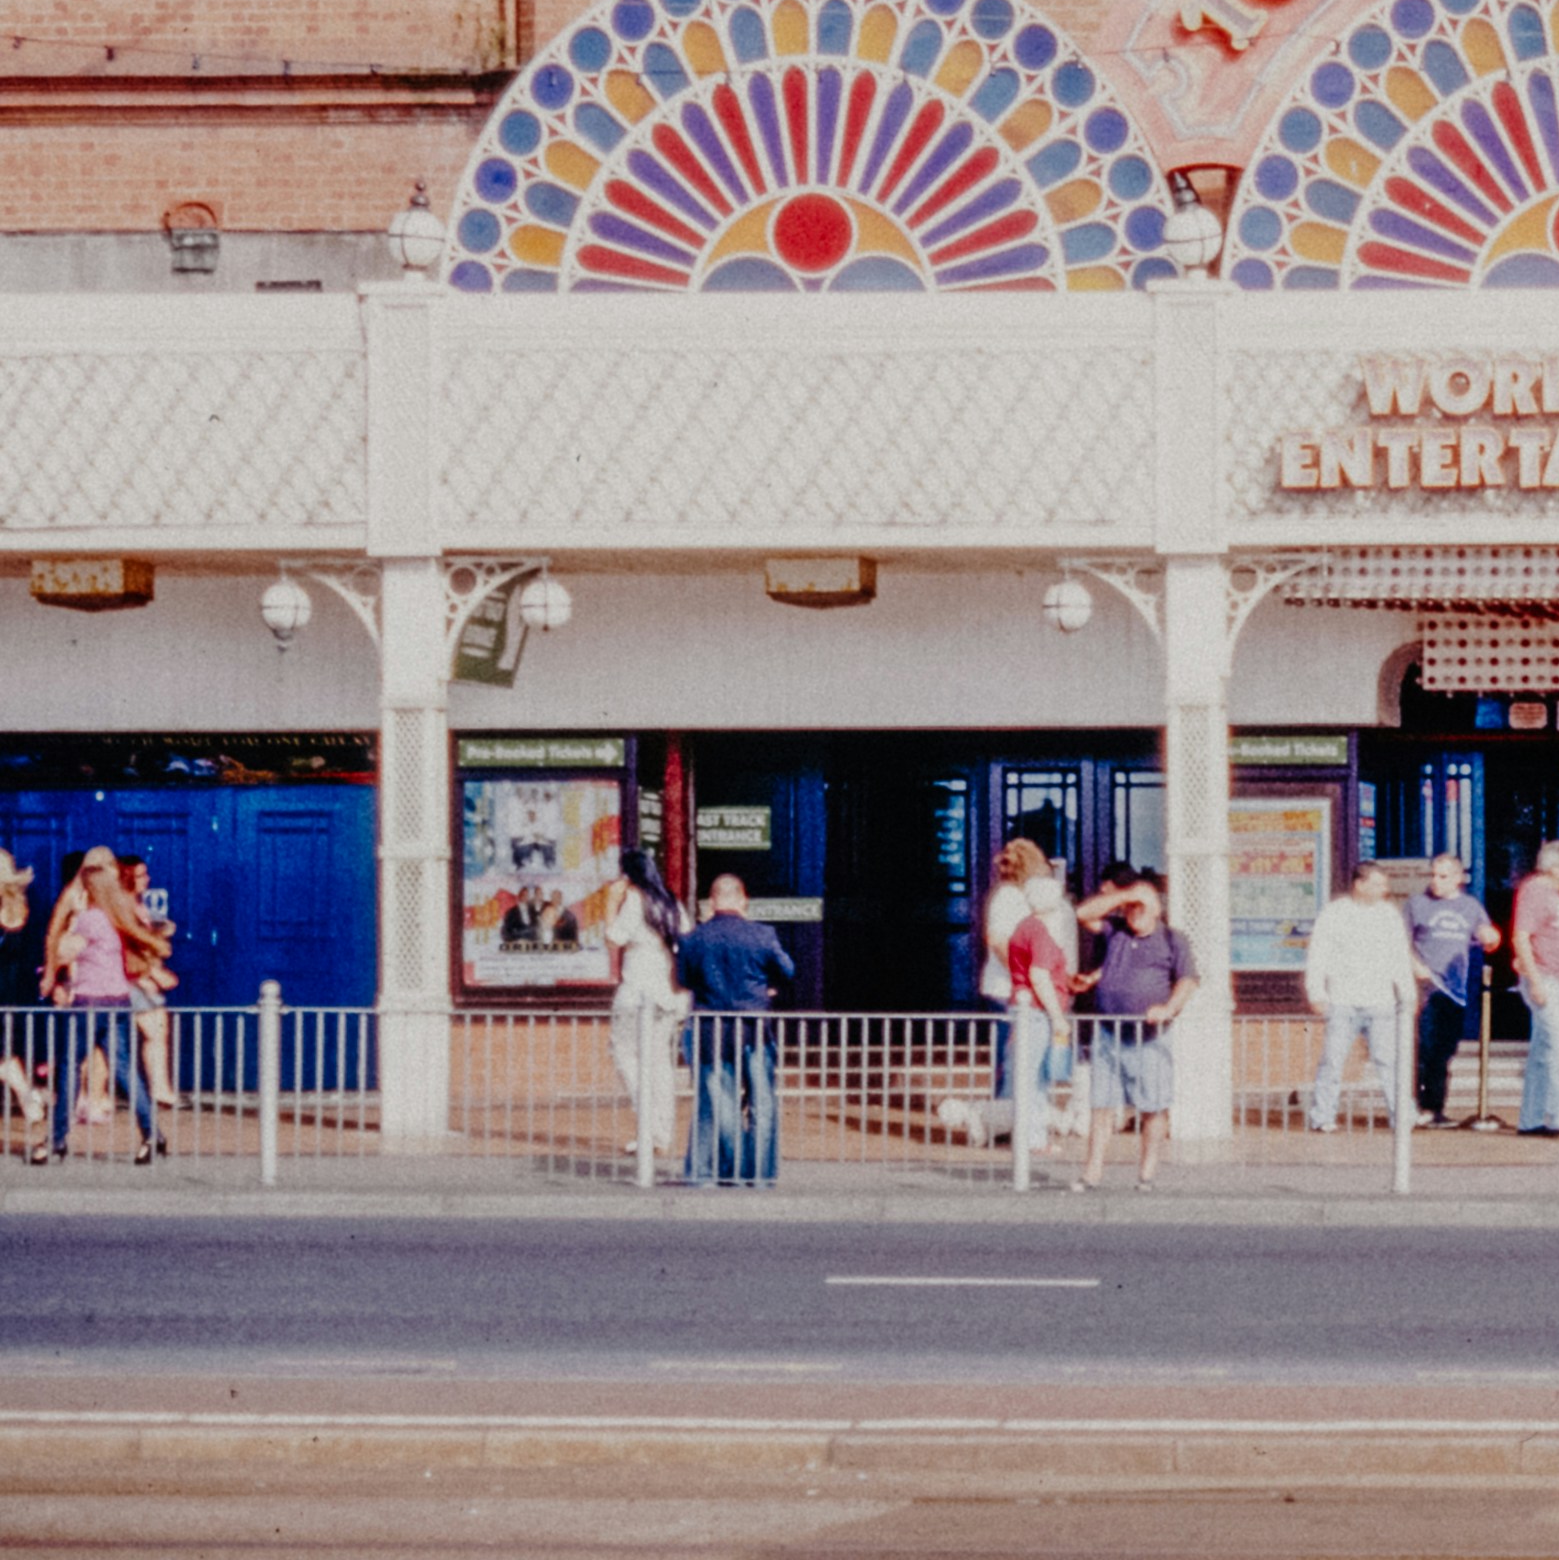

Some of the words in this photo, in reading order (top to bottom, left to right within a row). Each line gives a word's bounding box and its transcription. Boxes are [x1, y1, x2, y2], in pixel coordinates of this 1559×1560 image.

[548, 744, 593, 760] Tickets
[1232, 742, 1290, 757] -Booked
[1294, 743, 1338, 757] Tickets
[697, 814, 720, 827] AST
[725, 814, 766, 827] TRACK
